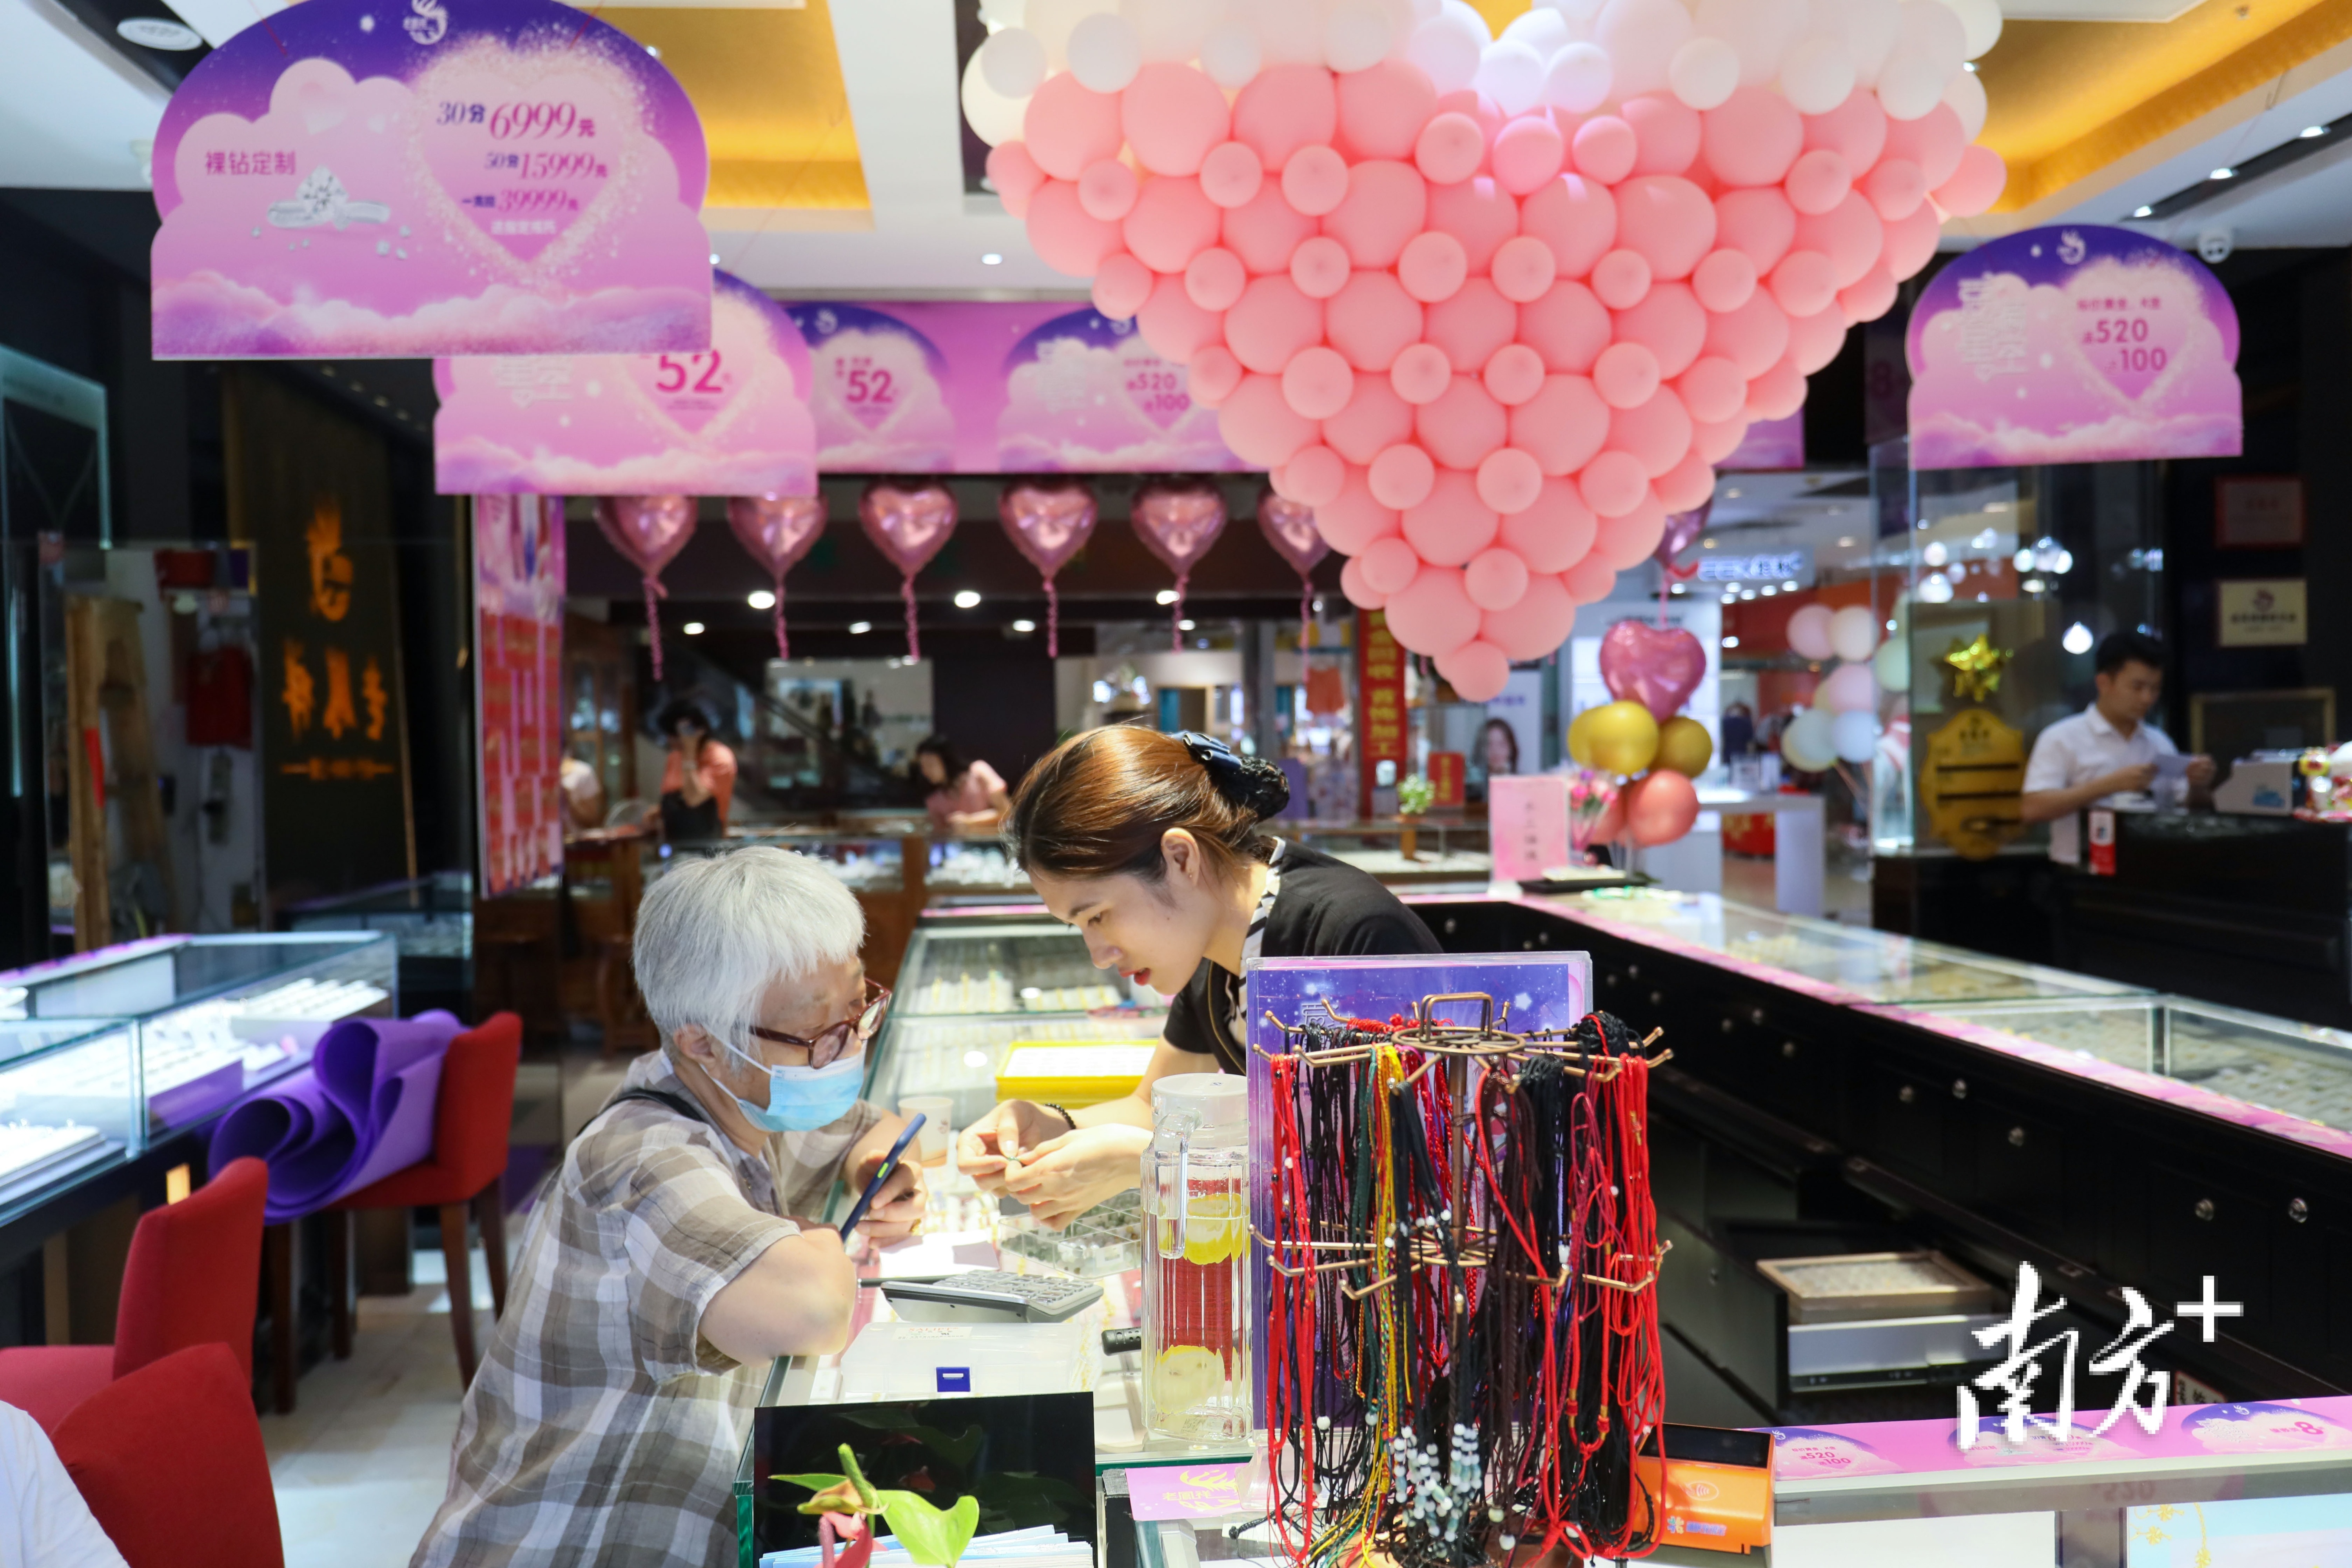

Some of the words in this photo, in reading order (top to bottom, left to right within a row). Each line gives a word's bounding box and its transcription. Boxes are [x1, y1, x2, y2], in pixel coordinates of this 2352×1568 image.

[206, 151, 296, 175] 裸钻定制
[847, 370, 893, 403] 52
